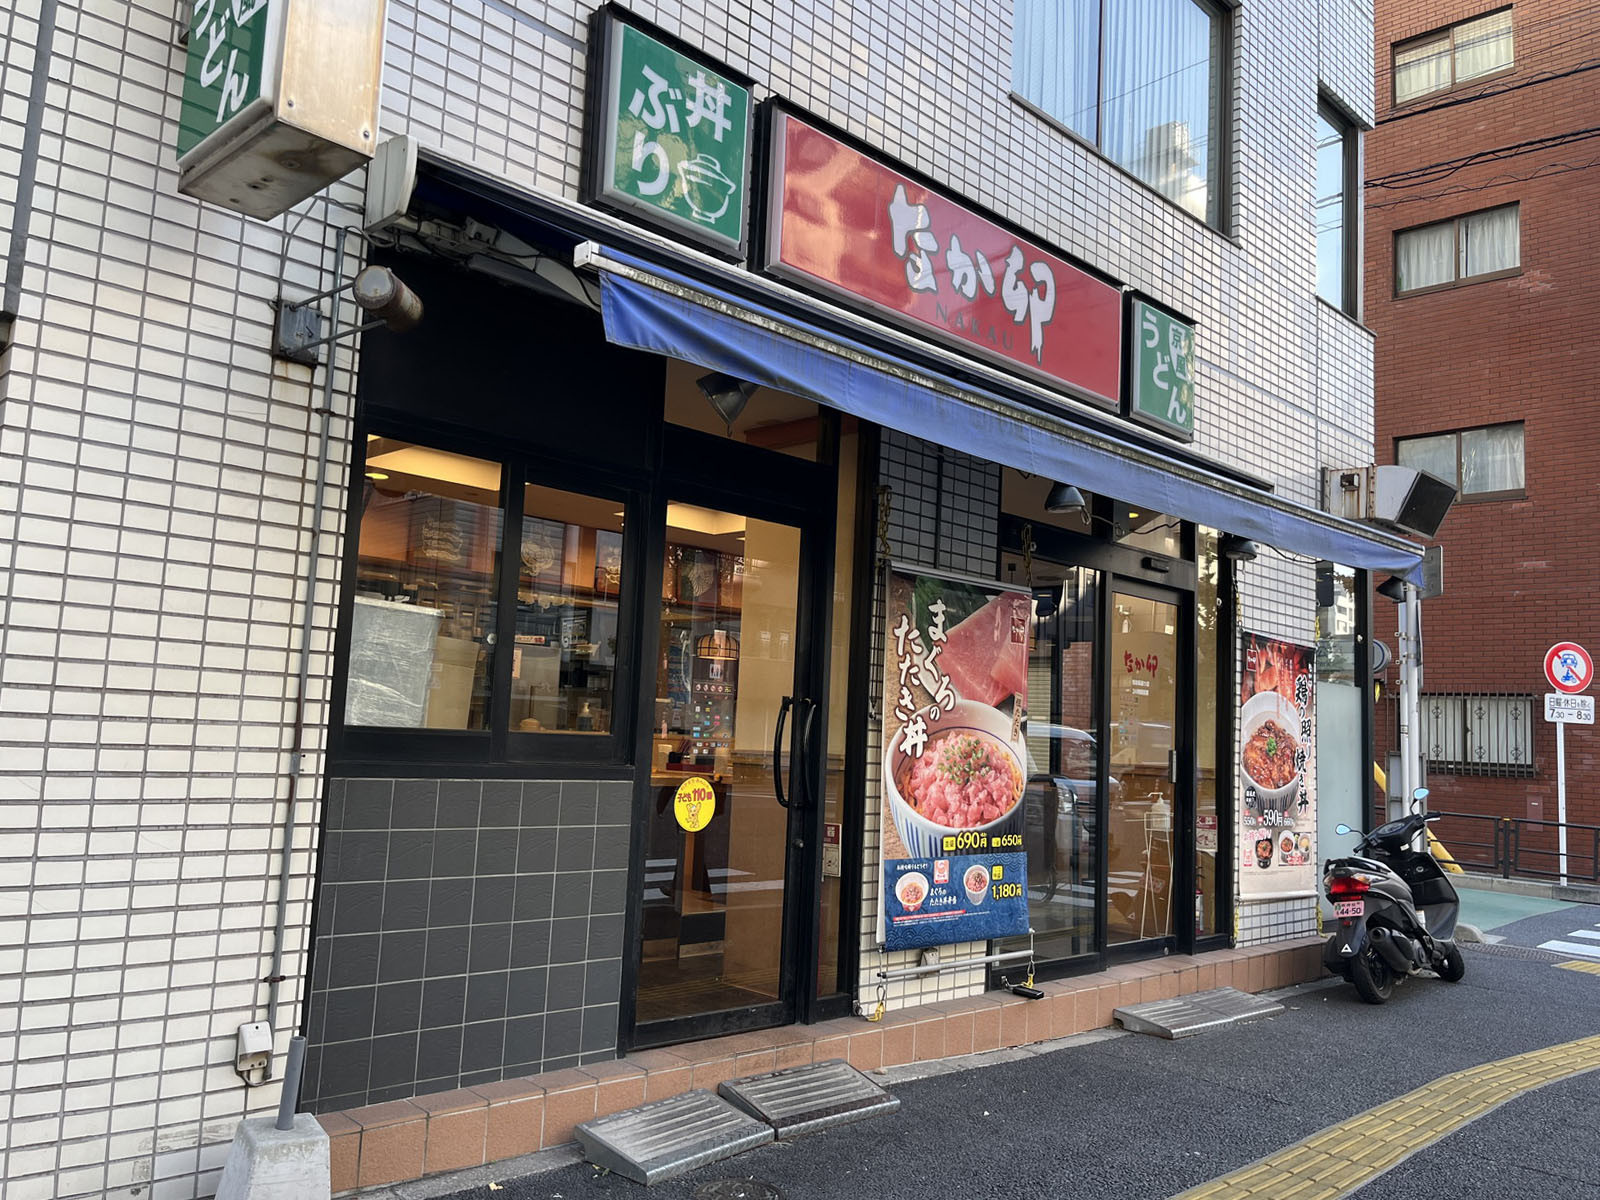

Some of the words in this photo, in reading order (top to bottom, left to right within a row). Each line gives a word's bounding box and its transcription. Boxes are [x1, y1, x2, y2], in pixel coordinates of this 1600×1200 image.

[628, 64, 683, 196] ぶり
[685, 70, 732, 143] 丼
[888, 183, 1056, 364] なか卯
[935, 302, 1014, 350] NAKAU
[1142, 310, 1187, 424] うどん
[893, 615, 929, 759] たたき丼
[924, 599, 956, 721] まぐろの
[1123, 650, 1159, 679] なか卯
